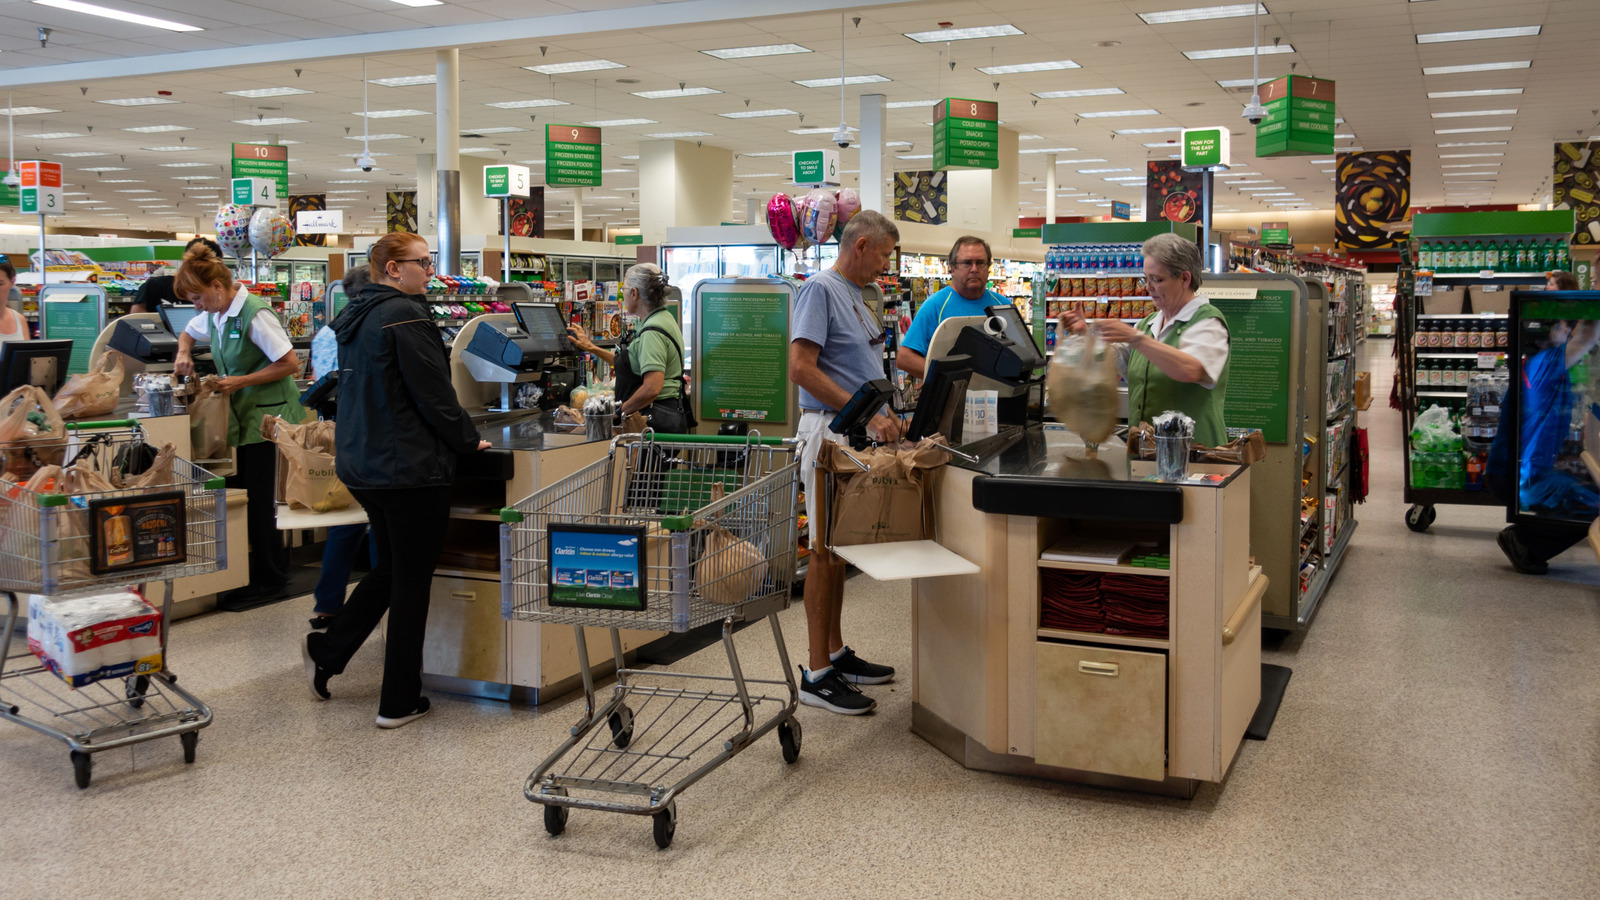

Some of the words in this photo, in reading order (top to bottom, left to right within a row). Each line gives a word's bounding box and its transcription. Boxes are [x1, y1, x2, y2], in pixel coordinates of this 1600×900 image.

[1312, 82, 1317, 95] 7
[970, 103, 978, 116] 8
[1301, 101, 1327, 110] CHAMPAGNE
[1311, 123, 1328, 131] COOLERS
[571, 129, 579, 140] 9
[254, 147, 268, 157] 10
[830, 159, 836, 176] 6
[517, 173, 524, 189] 5
[261, 186, 269, 200] 4
[47, 194, 56, 208] 3
[975, 410, 985, 419] $10
[110, 546, 129, 554] Crafted
[555, 547, 575, 555] Claritin
[138, 663, 152, 672] 48
